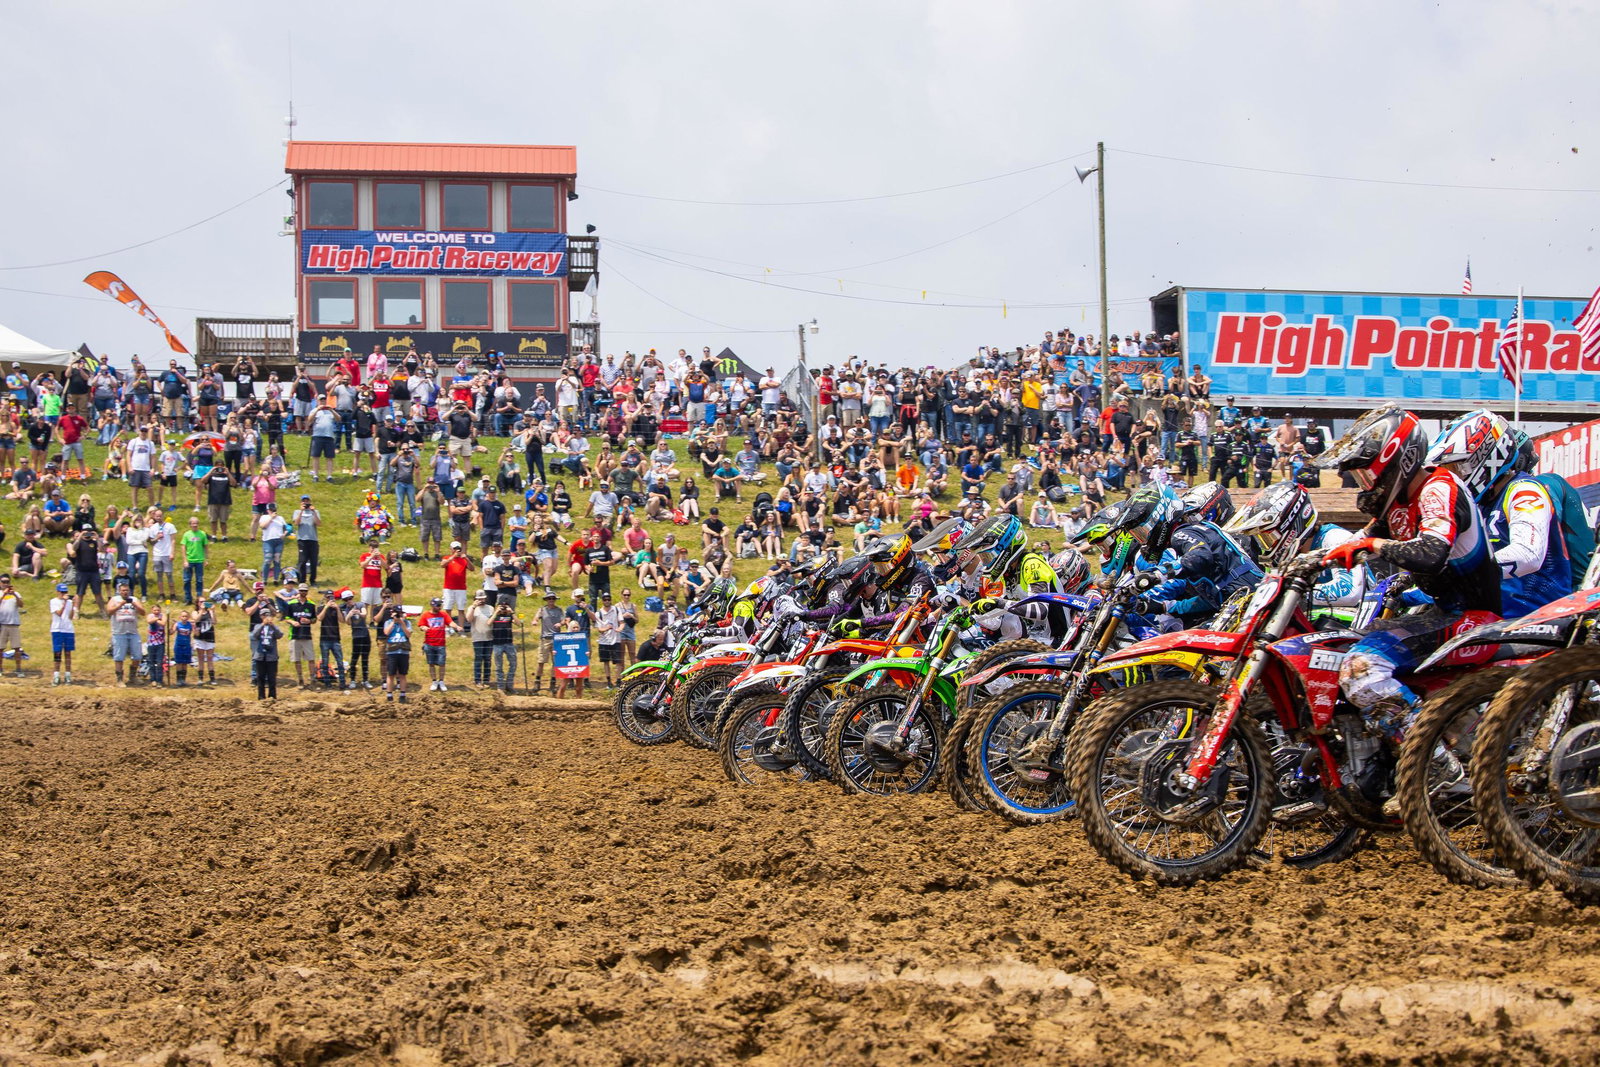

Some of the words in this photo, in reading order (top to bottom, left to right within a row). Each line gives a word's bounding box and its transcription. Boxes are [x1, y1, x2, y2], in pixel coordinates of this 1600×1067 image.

[376, 232, 467, 244] WELCOME
[471, 233, 495, 244] TO
[307, 245, 371, 272] High
[371, 245, 441, 270] Point
[444, 246, 564, 275] Raceway
[1212, 312, 1348, 377] High
[1348, 314, 1502, 373] Point
[1471, 433, 1513, 494] FXR
[566, 649, 579, 666] 1
